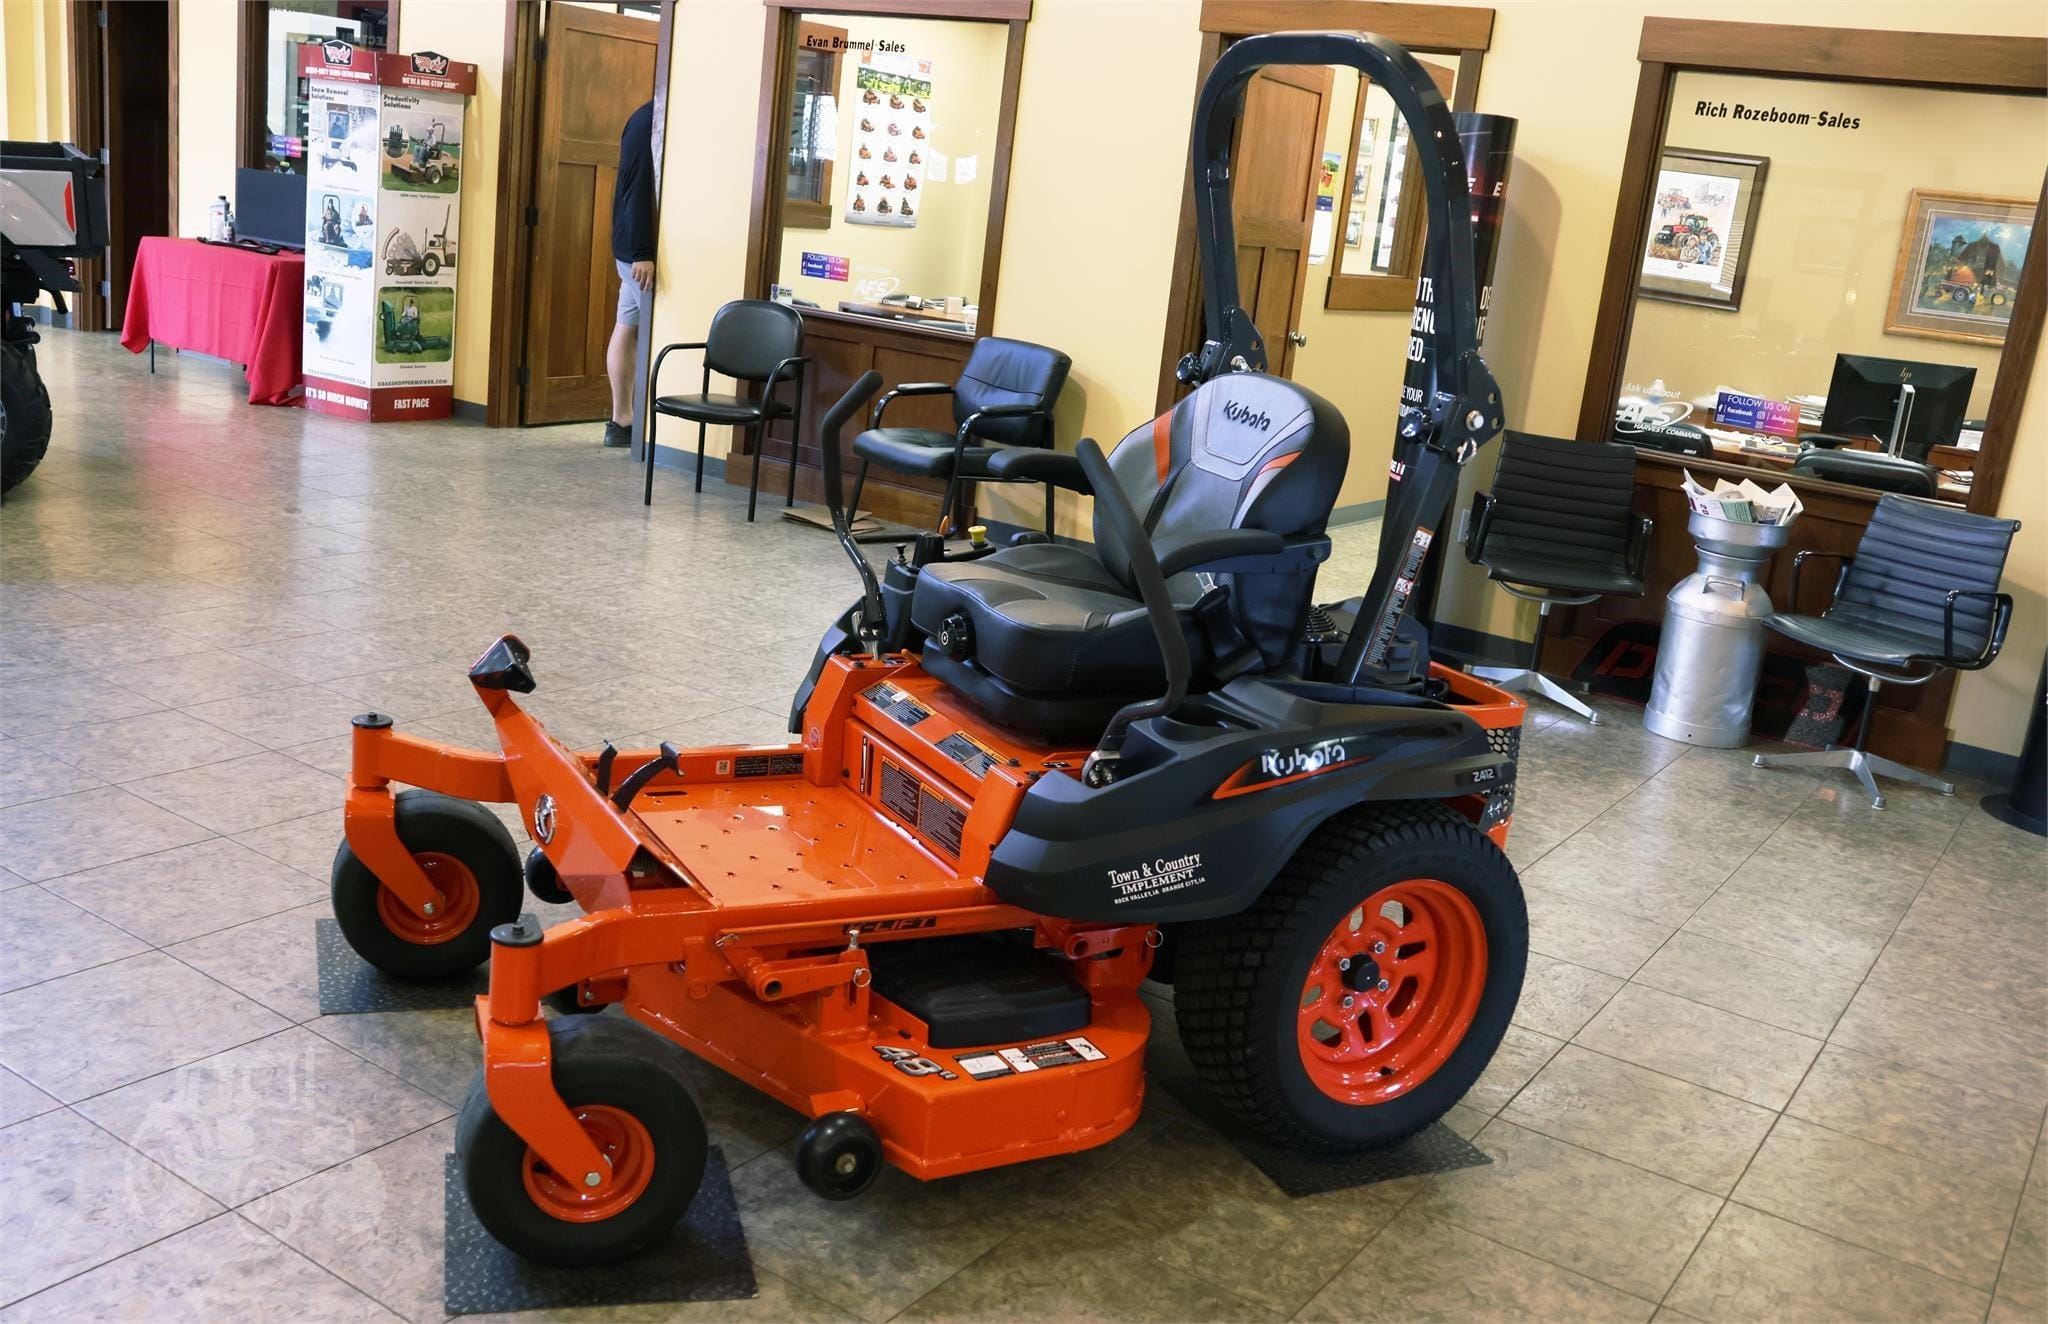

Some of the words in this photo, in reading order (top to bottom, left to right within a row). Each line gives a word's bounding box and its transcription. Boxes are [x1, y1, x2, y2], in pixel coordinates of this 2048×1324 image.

[806, 35, 829, 49] Evan
[383, 94, 420, 105] Productivity
[383, 101, 411, 110] Solutions
[1695, 100, 1728, 118] Rich
[807, 253, 828, 262] FOLLOW
[835, 257, 845, 265] ON
[1406, 387, 1424, 403] YOUR
[1624, 382, 1642, 393] Ask
[393, 398, 411, 410] FAST
[411, 397, 430, 409] PACE
[1727, 394, 1762, 407] FOLLOW
[1763, 401, 1774, 410] US
[1776, 403, 1791, 413] ON
[1727, 406, 1754, 417] facebook
[1223, 399, 1272, 432] Kubota
[1633, 422, 1666, 434] HARVEST
[1665, 428, 1702, 440] COMMAND
[1261, 741, 1346, 777] Kubota
[1472, 768, 1495, 783] Z412
[1107, 869, 1140, 885] Town
[1141, 862, 1153, 877] &
[1155, 853, 1201, 874] Country
[1121, 868, 1194, 895] IMPLEMENT
[1114, 897, 1130, 905] ROCK
[1161, 883, 1185, 893] ORANGE
